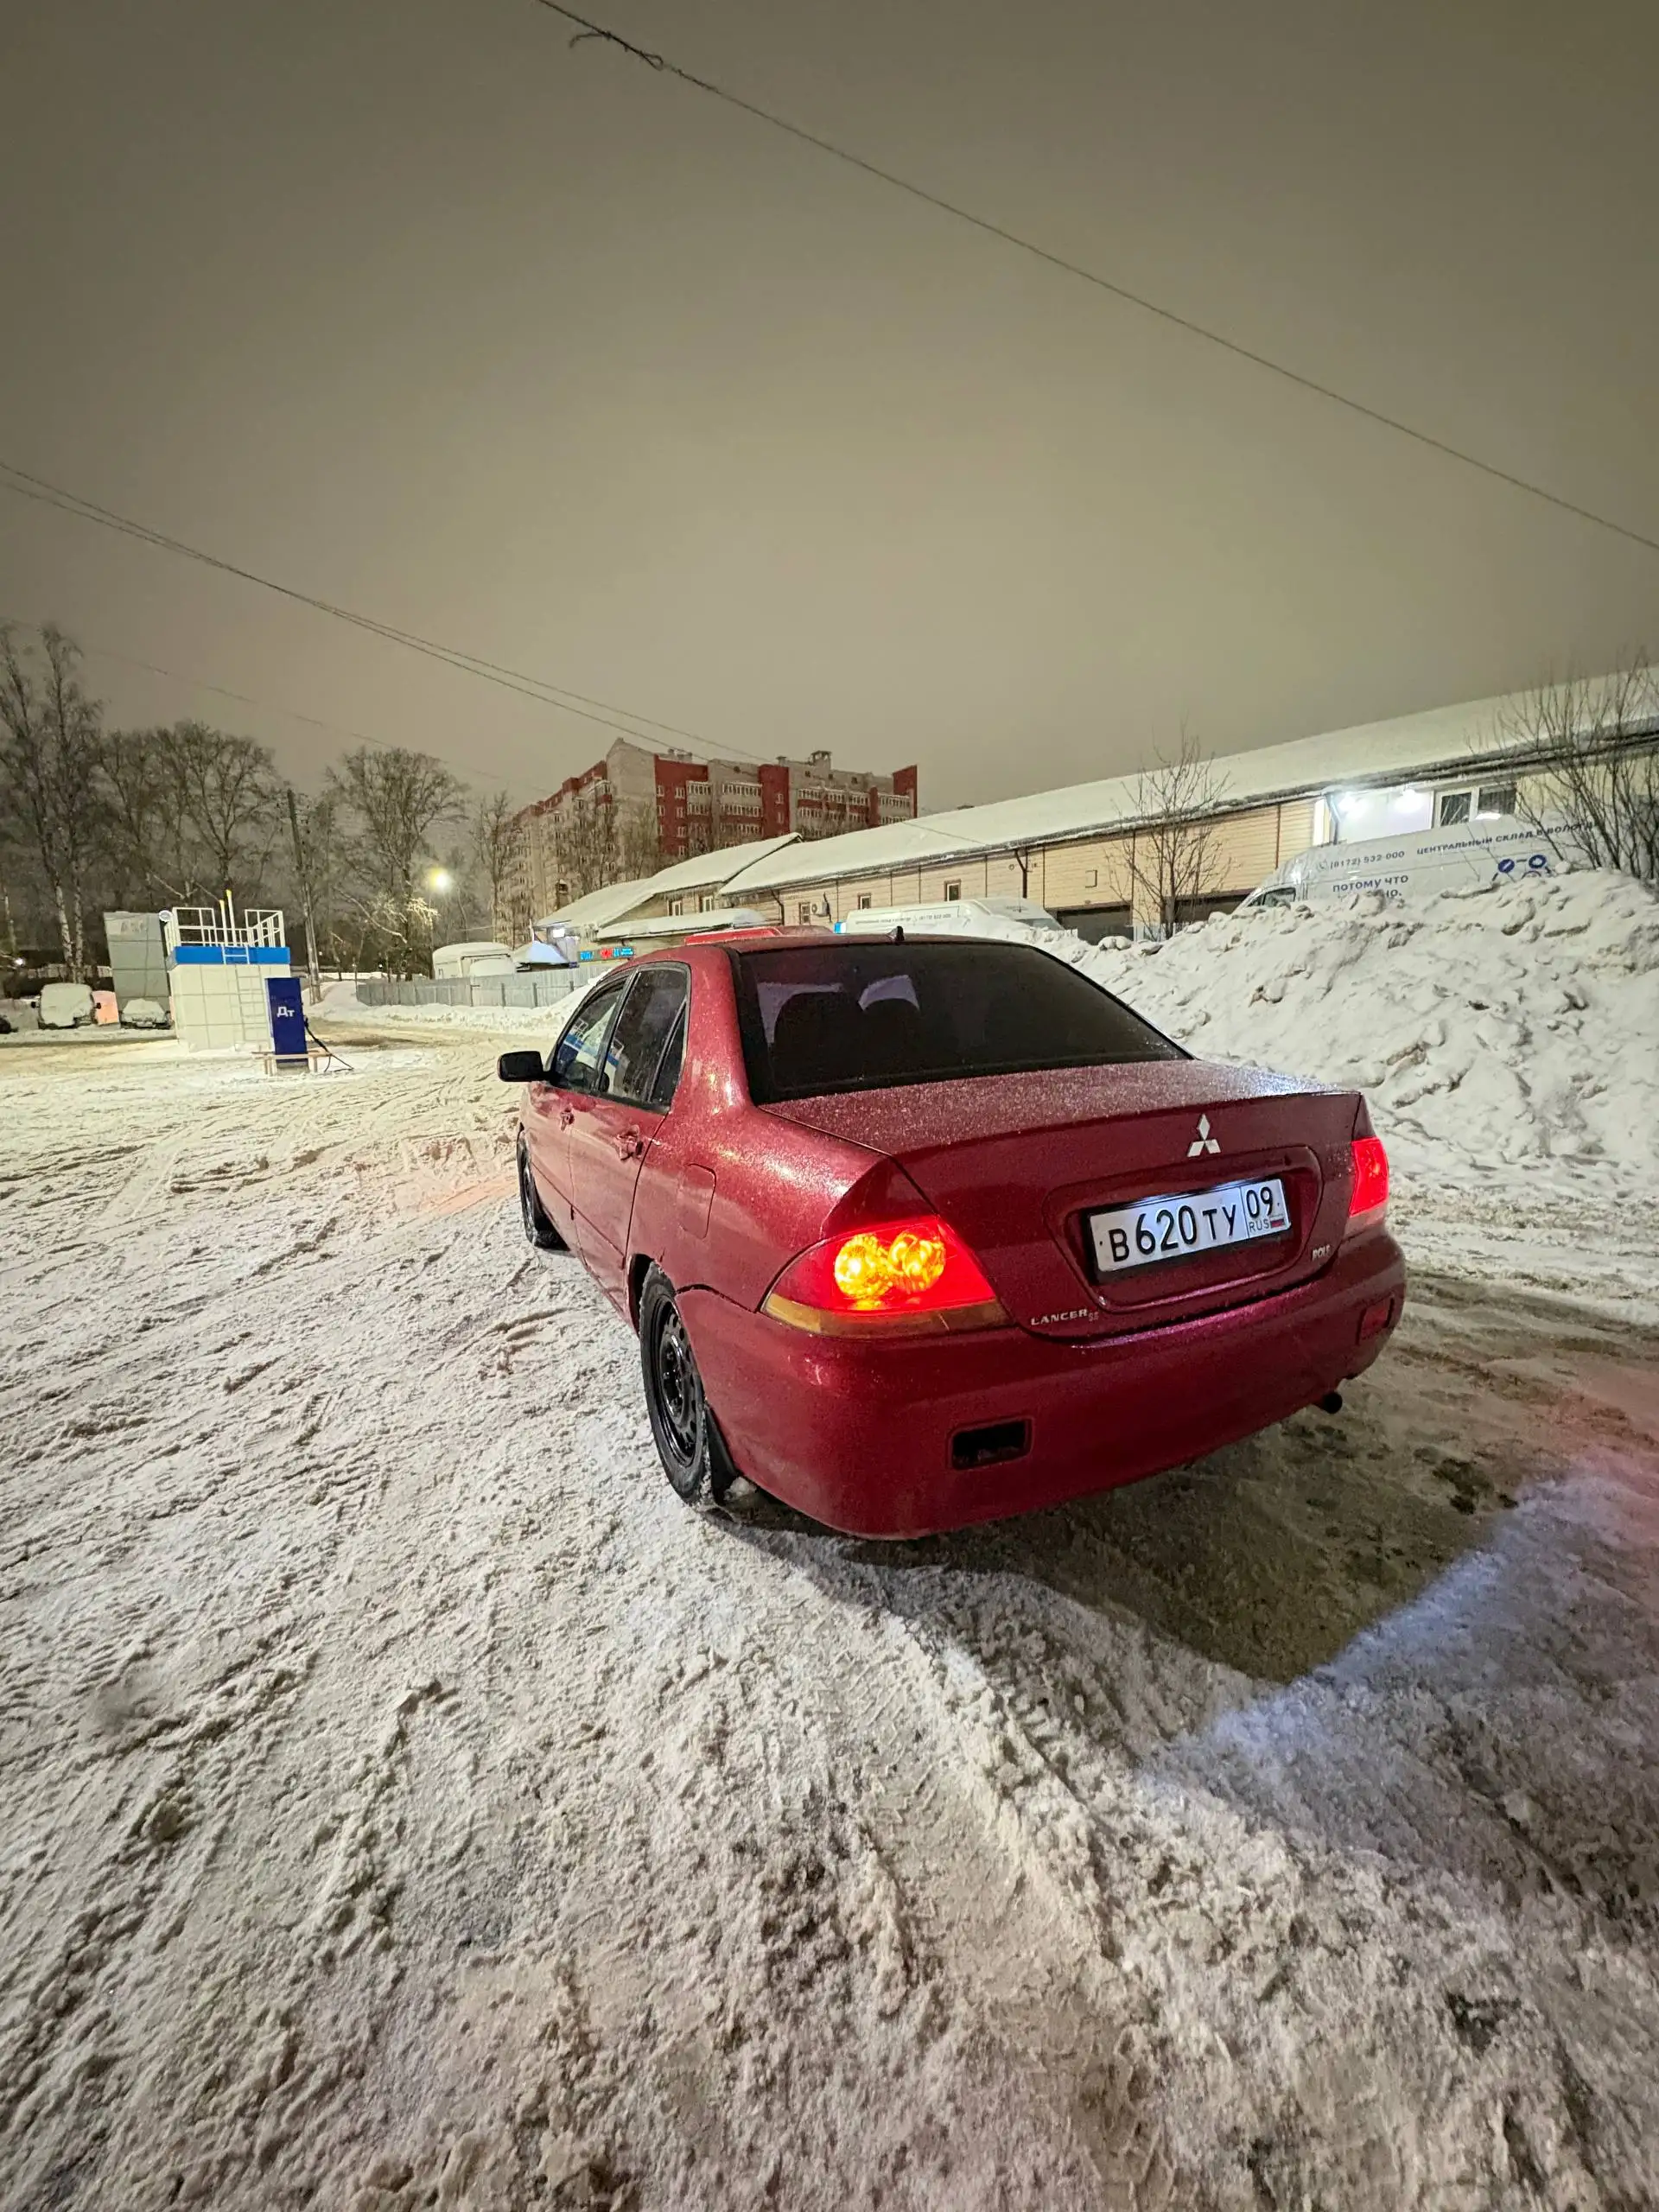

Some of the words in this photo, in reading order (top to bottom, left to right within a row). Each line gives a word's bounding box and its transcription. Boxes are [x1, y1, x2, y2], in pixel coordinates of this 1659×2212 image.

[1416, 837, 1492, 854] ЦЕНТРАЛЬНЫЙ
[1495, 830, 1534, 843] СКЛАД
[1363, 854, 1382, 864] 532
[1385, 850, 1405, 860] 000
[1332, 878, 1382, 893] ПОТОМУ
[1384, 874, 1409, 885] ЧТО
[1245, 1186, 1274, 1219] 09
[1248, 1218, 1270, 1233] RUS
[1031, 1308, 1088, 1326] LANCER
